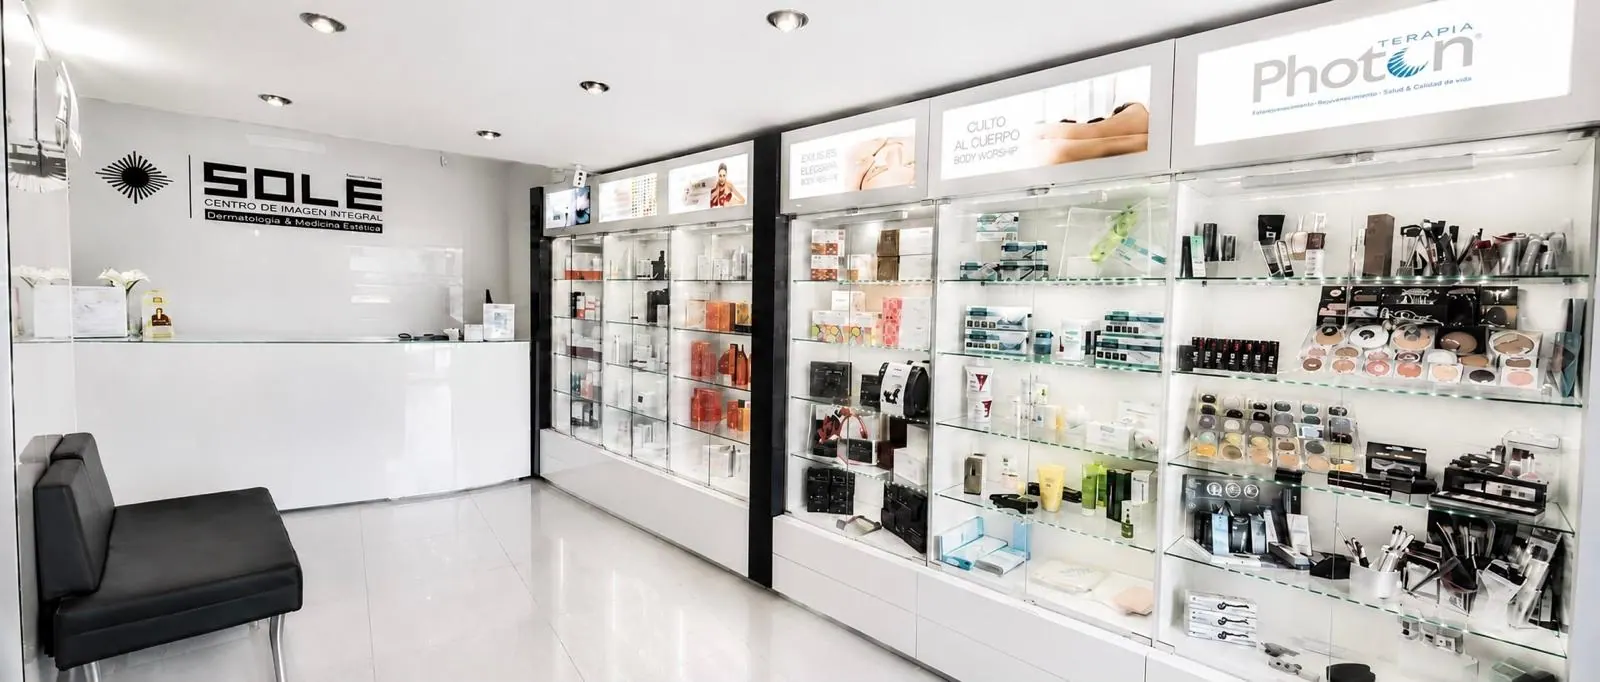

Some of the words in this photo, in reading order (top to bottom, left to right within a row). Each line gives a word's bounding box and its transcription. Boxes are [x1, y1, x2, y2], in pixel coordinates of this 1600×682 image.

[1377, 22, 1474, 48] TERAPIA
[1413, 79, 1442, 90] Calidad
[967, 115, 1006, 133] CULTO
[954, 140, 968, 152] AL
[971, 128, 1020, 149] CUERPO
[954, 152, 977, 165] BODY
[203, 161, 383, 213] SOLE
[204, 198, 257, 211] CENTRO
[260, 203, 278, 213] DE
[281, 204, 327, 217] IMAGEN
[330, 209, 383, 222] INTEGRAL
[284, 217, 292, 225] &
[295, 218, 340, 229] Medicina
[343, 222, 381, 232] Estética
